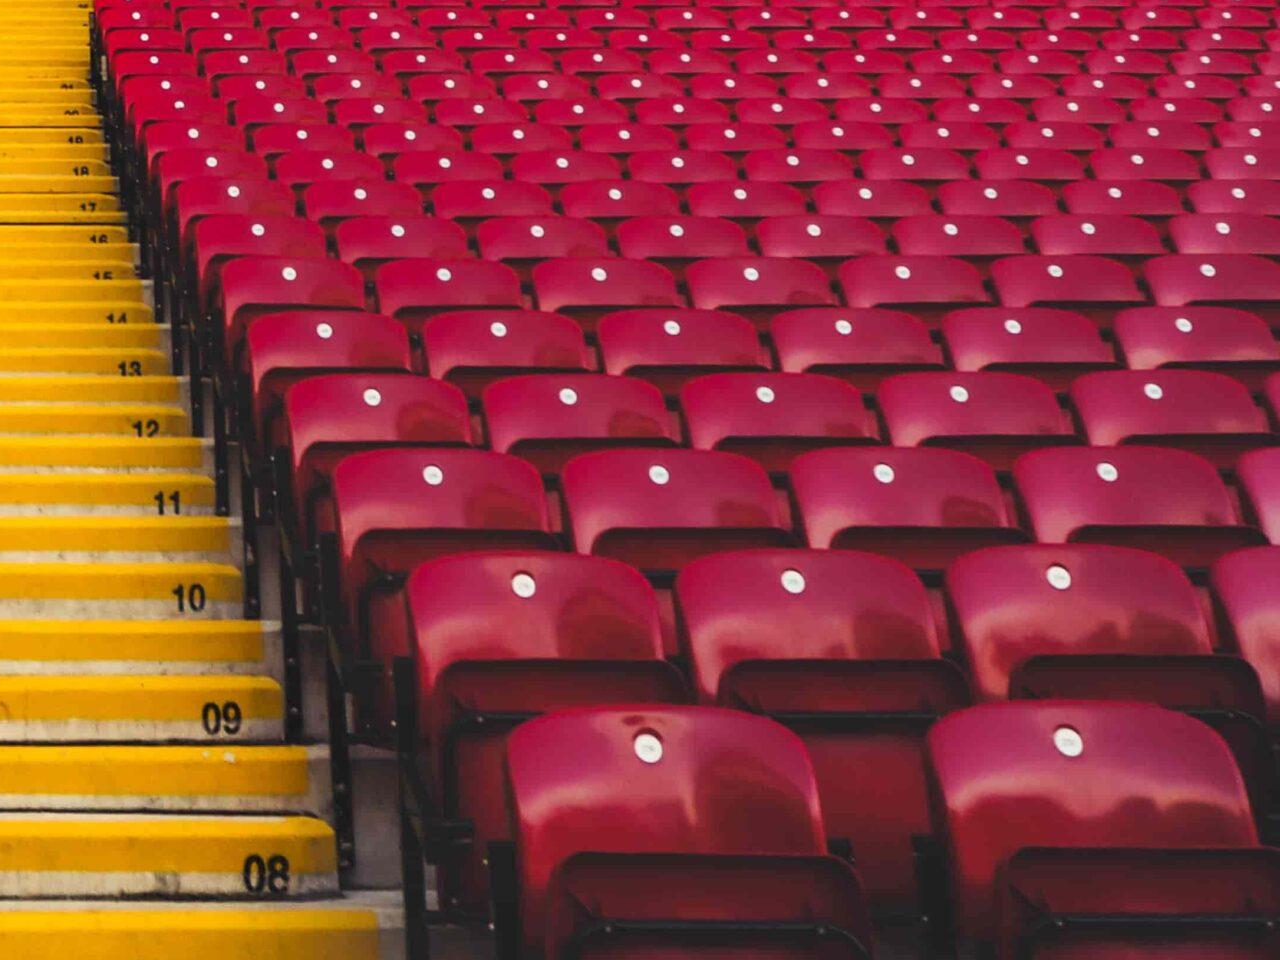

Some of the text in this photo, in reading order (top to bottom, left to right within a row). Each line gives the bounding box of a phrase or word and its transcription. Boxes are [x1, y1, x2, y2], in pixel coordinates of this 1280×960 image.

[118, 360, 142, 376] 13
[132, 419, 160, 437] 12
[153, 490, 180, 516] 11
[171, 583, 206, 613] 10
[201, 701, 242, 735] 09
[242, 853, 290, 894] 08
